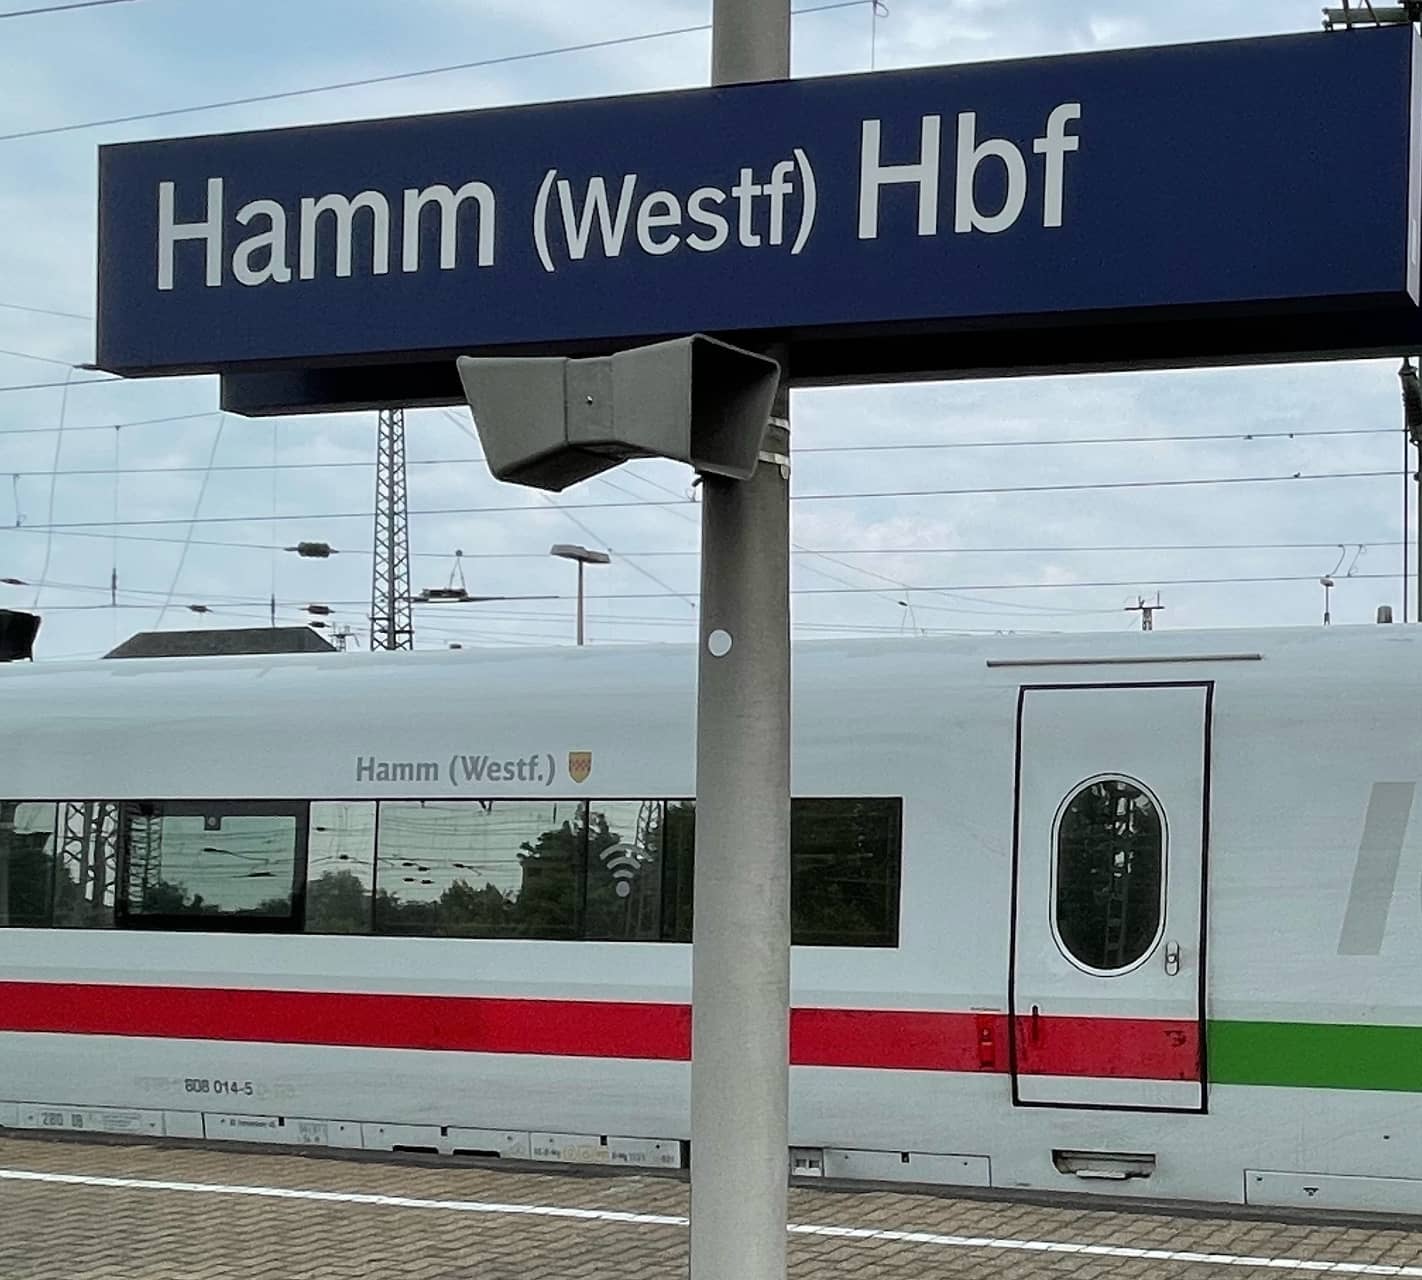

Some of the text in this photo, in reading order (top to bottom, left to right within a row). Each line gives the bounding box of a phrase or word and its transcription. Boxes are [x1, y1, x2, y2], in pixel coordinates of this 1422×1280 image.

[157, 102, 1082, 291] Hamm (Westf) Hbf
[355, 753, 557, 787] Hamm (Westf.)
[213, 1080, 253, 1096] 014-5
